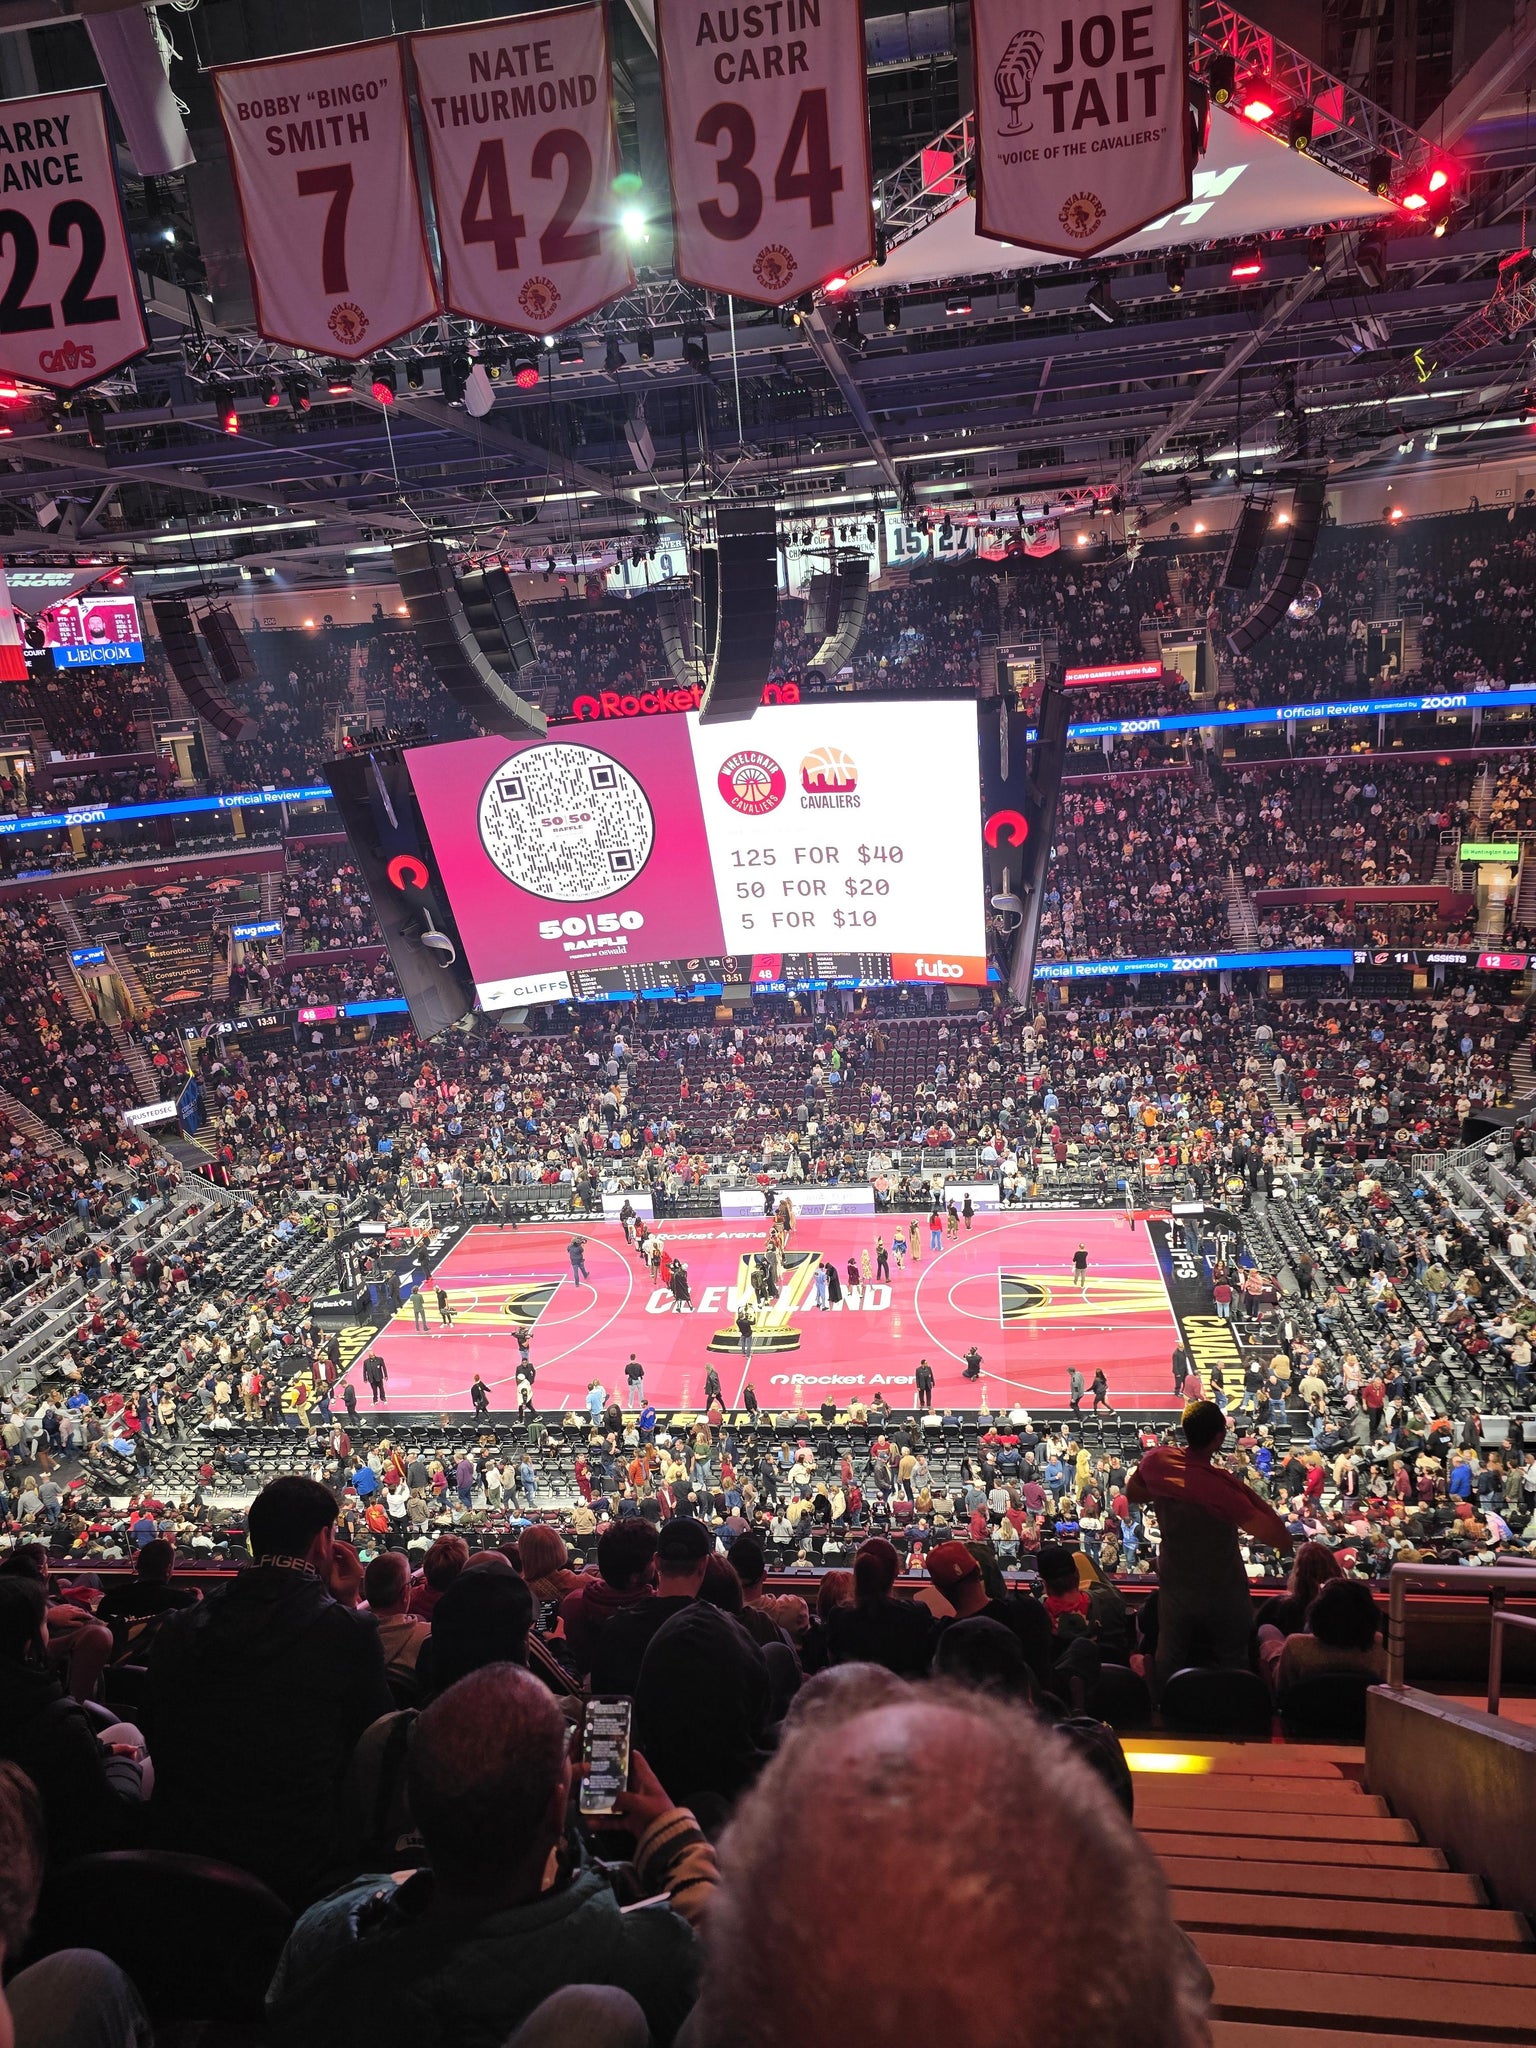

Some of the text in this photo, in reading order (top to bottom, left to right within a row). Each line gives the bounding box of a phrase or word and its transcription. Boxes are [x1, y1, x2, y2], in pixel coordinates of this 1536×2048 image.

[696, 0, 822, 46] AUSTIN
[1053, 6, 1154, 74] JOE
[469, 39, 555, 83] NATE
[713, 39, 810, 85] CARR
[237, 78, 389, 121] BOBBY “BINGO”
[431, 74, 598, 128] THURMOND
[1043, 64, 1166, 134] TAIT
[266, 111, 370, 156] SMITH
[1044, 146, 1060, 160] OF
[1063, 143, 1088, 157] THE
[0, 153, 83, 194] ANCE
[696, 88, 843, 242] 34
[460, 129, 602, 270] 42
[1058, 191, 1107, 222] CAVALIERS
[297, 163, 355, 295] 7
[0, 199, 120, 333] 22
[752, 244, 798, 274] CAVALIERS
[518, 276, 561, 305] CAVALIERS
[39, 340, 97, 373] CAVS
[893, 522, 922, 556] 15
[660, 554, 673, 579] 9
[600, 683, 703, 718] Rocket
[1283, 705, 1324, 719] Official
[1327, 703, 1370, 715] Review
[1374, 701, 1408, 710] presented
[1421, 695, 1467, 709] zoom
[1080, 724, 1108, 734] presented
[1110, 723, 1118, 732] by
[1121, 718, 1161, 732] zoom
[720, 753, 779, 776] WHEELCHAIR
[226, 789, 333, 806] Official Review presented
[731, 794, 779, 813] CAVALIERS
[800, 795, 861, 809] CAVALIERS
[20, 820, 52, 828] presented
[64, 811, 105, 824] zoom
[731, 843, 904, 867] 125 FOR $40
[736, 878, 890, 899] 50 FOR $20
[234, 922, 280, 936] drug mart
[742, 909, 877, 929] 5 FOR $10
[147, 929, 181, 939] Cleaning.
[563, 935, 628, 951] RAFFLE
[89, 951, 104, 959] mart
[149, 947, 194, 958] Restoration.
[599, 946, 627, 956] oswald
[1395, 953, 1409, 963] 11
[1427, 954, 1467, 963] ASSISTS
[914, 957, 964, 979] fubo
[1076, 964, 1119, 975] Review
[1125, 963, 1158, 971] presented
[1172, 957, 1217, 970] zoom
[1486, 957, 1500, 966] 12
[155, 968, 202, 980] Construction.
[692, 973, 706, 983] 43
[722, 974, 742, 982] 13:51
[759, 970, 772, 979] 48
[514, 981, 569, 996] CLIFFS
[218, 1023, 232, 1032] 43
[257, 1016, 277, 1026] 13:51
[303, 1010, 316, 1019] 48
[986, 1201, 1080, 1209] TRUSTEDSEC
[657, 1231, 767, 1241] Rocket Arena
[313, 1300, 339, 1309] KeyBank
[790, 1374, 867, 1385] Rocket
